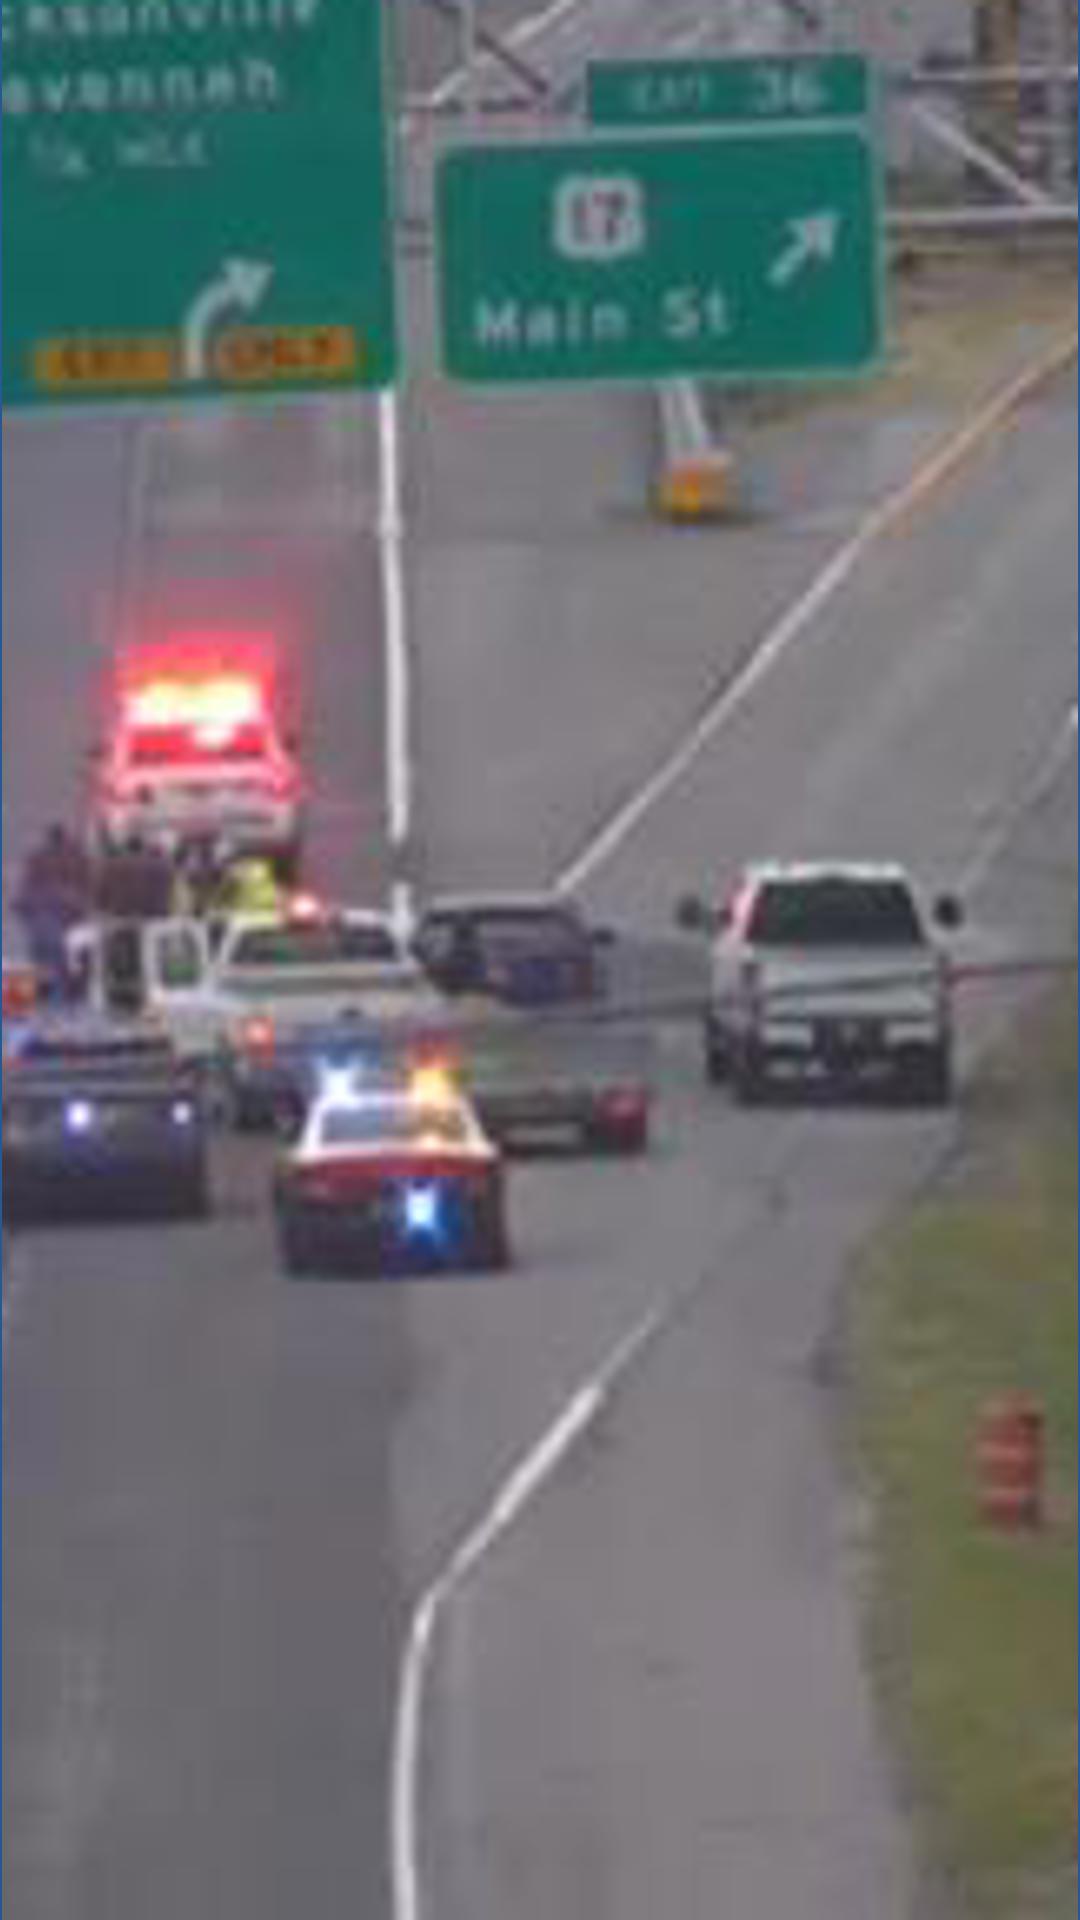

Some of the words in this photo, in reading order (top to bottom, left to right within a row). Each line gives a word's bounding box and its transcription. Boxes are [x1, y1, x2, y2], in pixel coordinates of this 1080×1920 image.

[750, 68, 830, 114] 36
[569, 188, 628, 247] 17
[473, 294, 629, 348] Main
[660, 279, 733, 340] St
